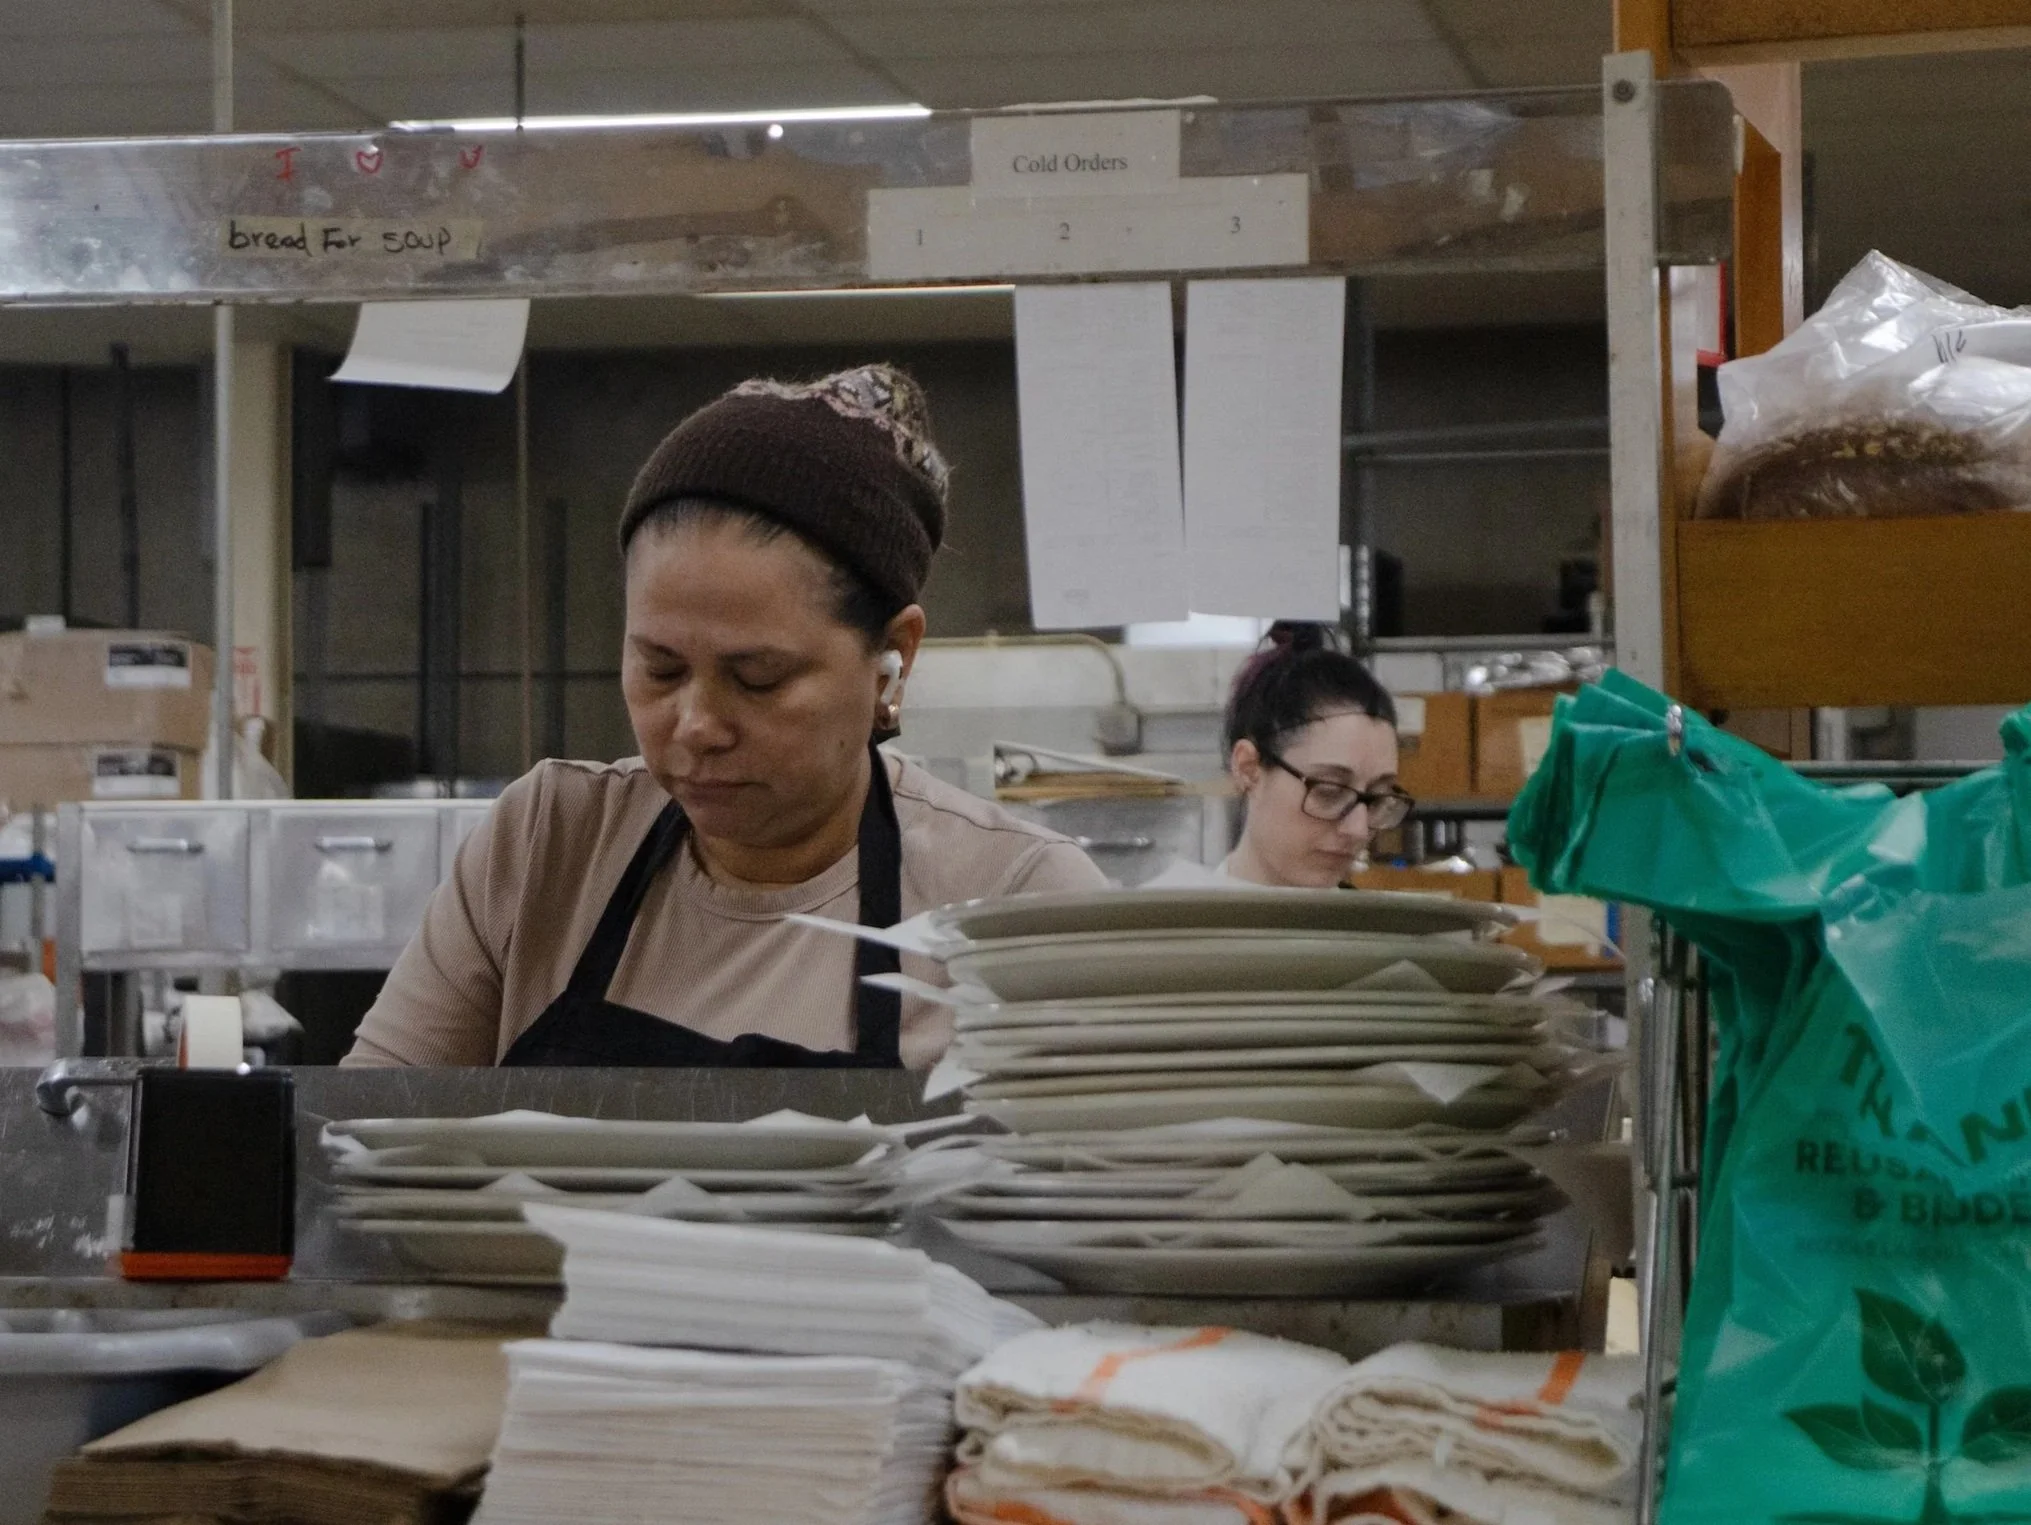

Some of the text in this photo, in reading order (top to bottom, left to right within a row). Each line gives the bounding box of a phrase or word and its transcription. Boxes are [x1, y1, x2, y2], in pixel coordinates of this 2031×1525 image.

[1012, 152, 1128, 174] Cold Orders
[228, 220, 313, 258] bread
[382, 226, 452, 256] soup
[916, 215, 1242, 246] 1 2 3
